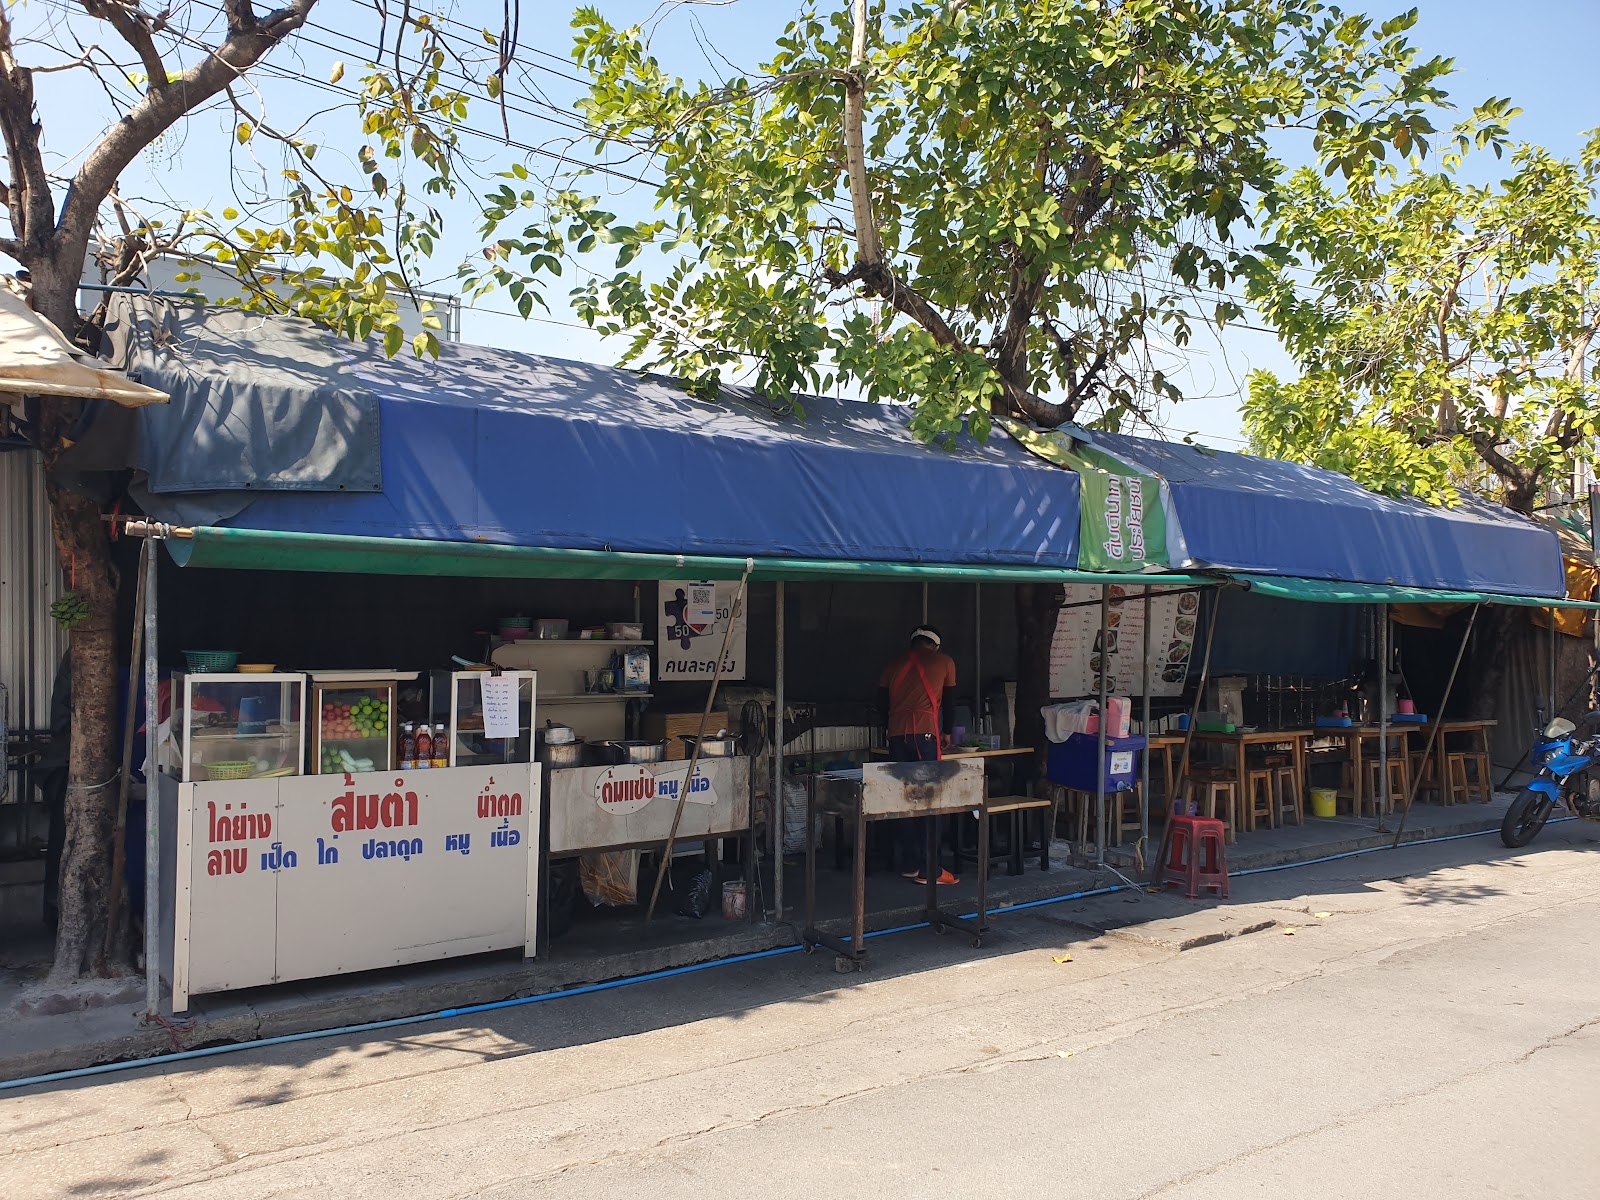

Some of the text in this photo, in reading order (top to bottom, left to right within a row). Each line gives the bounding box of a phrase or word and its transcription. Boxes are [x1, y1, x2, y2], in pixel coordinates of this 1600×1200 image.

[715, 607, 729, 620] 50
[674, 625, 690, 638] 50
[601, 768, 655, 804] ต้มแซ่บ
[658, 779, 678, 799] หมู
[207, 772, 522, 843] ไก่ย่าง ส้มตำ น้ำตก
[207, 817, 521, 876] ลาบ เป็ด ไก่ ปลาดุก หมู เนื้อ
